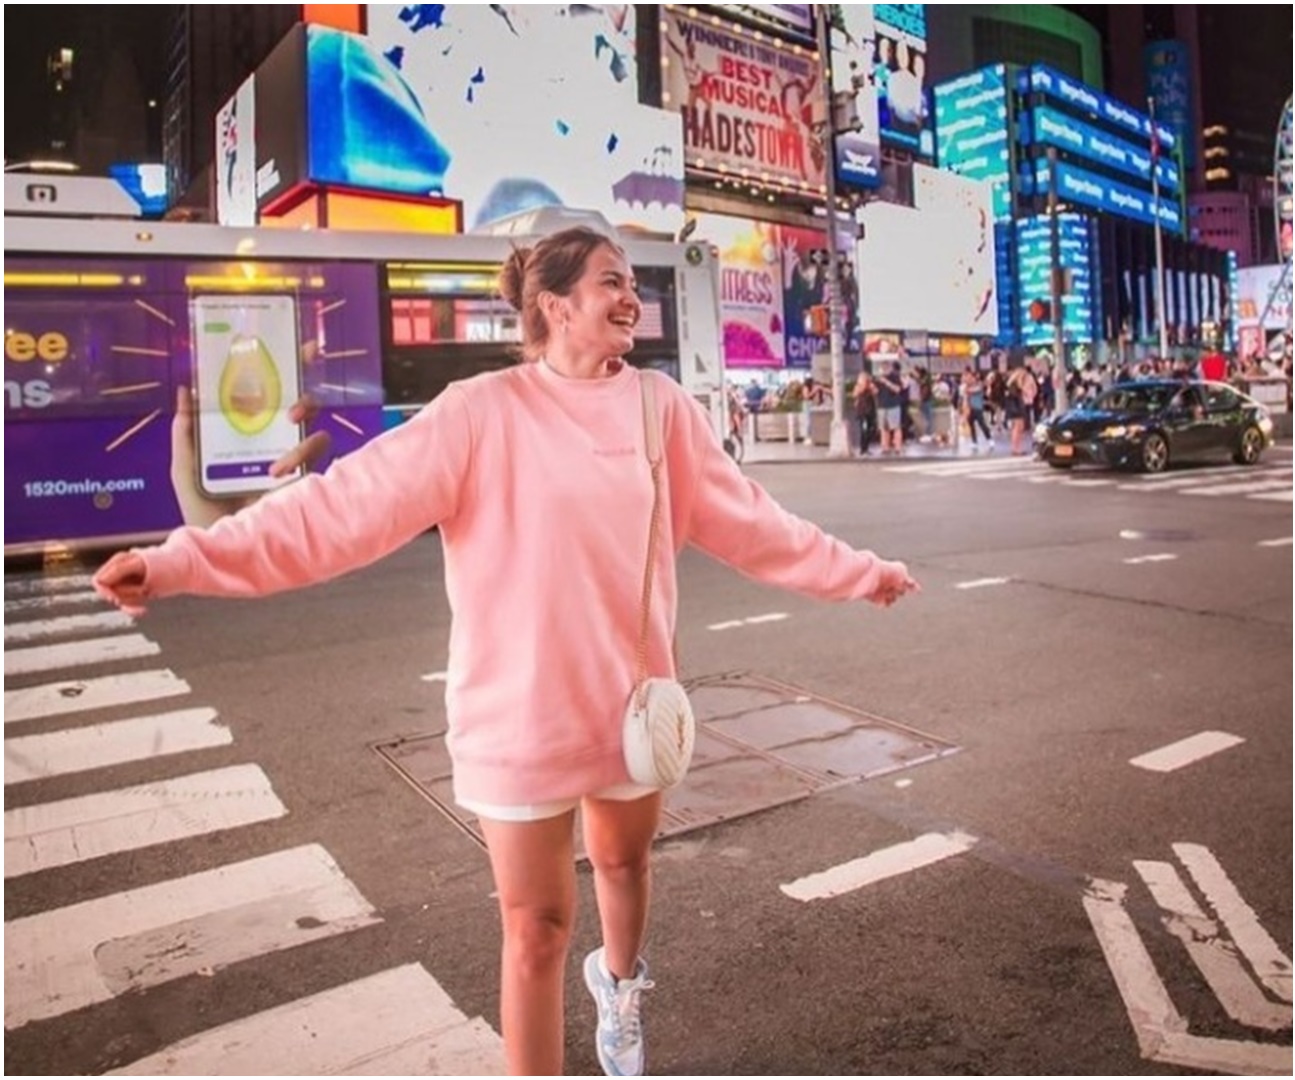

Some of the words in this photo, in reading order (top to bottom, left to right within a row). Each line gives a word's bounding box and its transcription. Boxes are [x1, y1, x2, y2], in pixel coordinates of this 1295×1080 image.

[720, 54, 772, 90] BEST
[681, 104, 803, 170] HADESTOWN
[24, 478, 144, 498] 1520min.com
